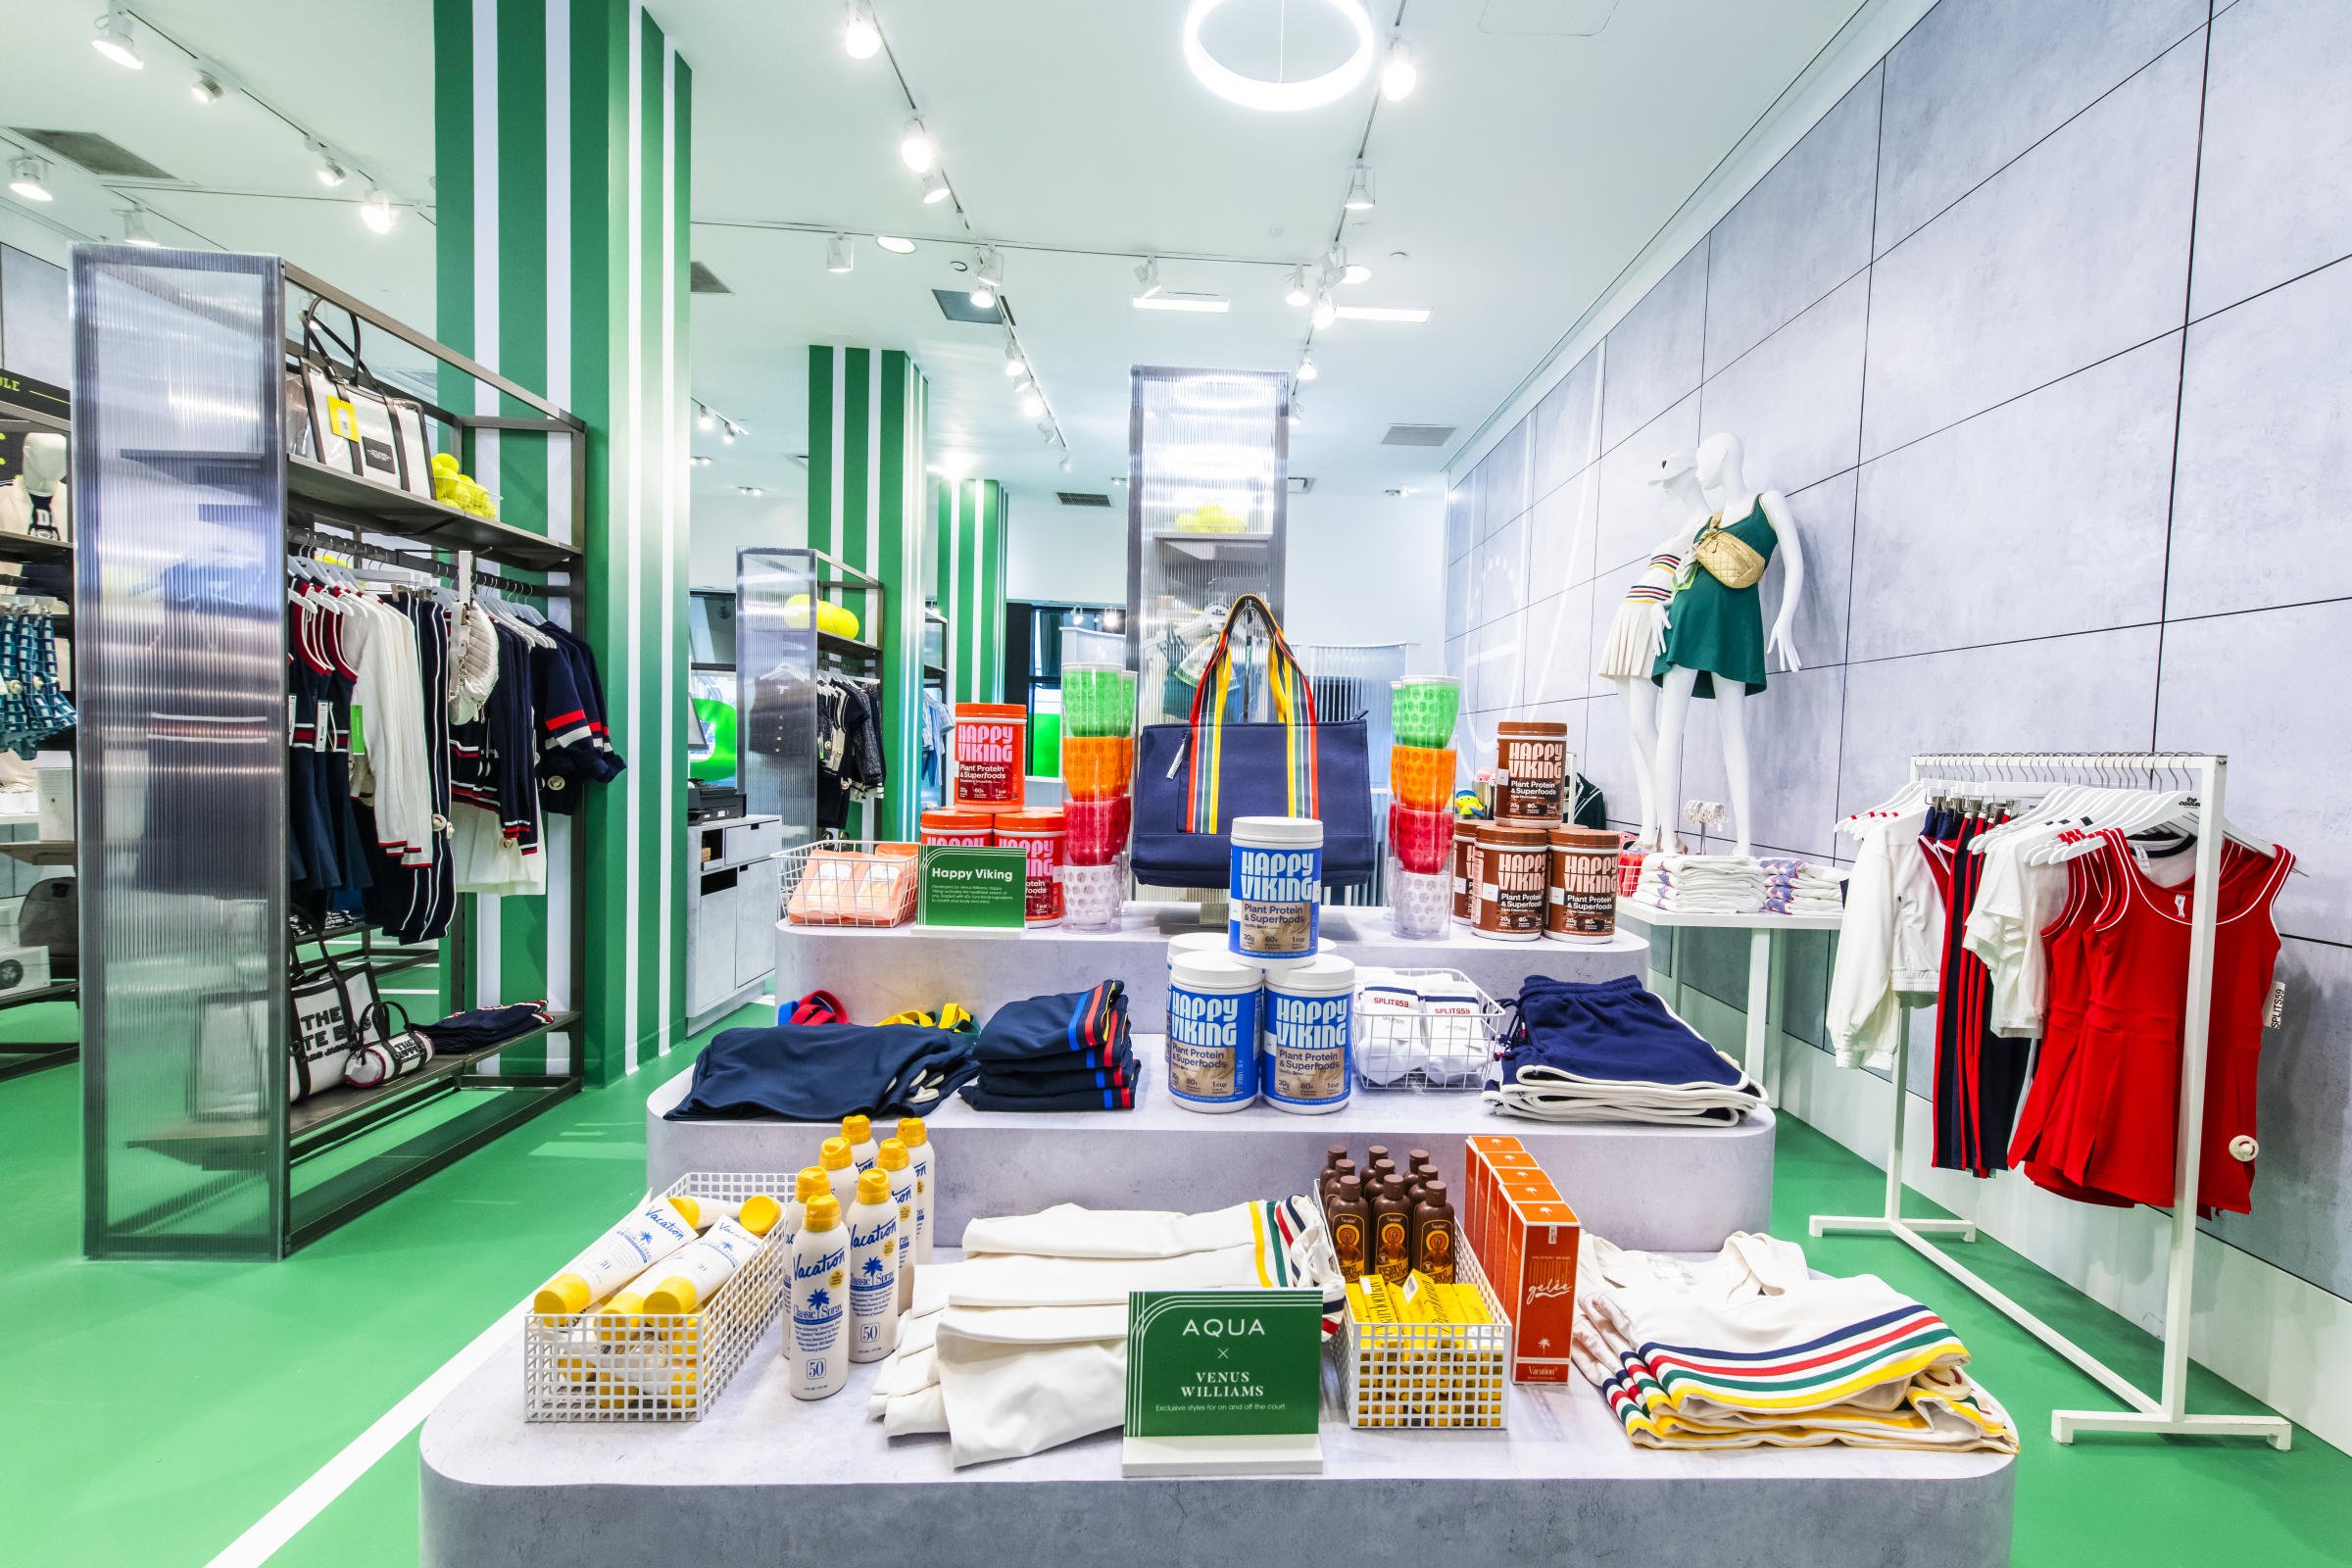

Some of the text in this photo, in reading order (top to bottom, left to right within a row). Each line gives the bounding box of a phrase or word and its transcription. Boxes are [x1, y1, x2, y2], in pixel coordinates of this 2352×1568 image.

[957, 724, 1013, 744] HAPPY
[957, 743, 1013, 762] VIKING
[1509, 742, 1563, 760] HAPPY
[1508, 760, 1562, 779] VIKING
[1026, 858, 1054, 876] ING
[1241, 851, 1314, 877] HAPPY
[1564, 855, 1618, 875] HAPPY
[932, 867, 1013, 882] Happy Viking
[1563, 872, 1617, 894] VIKING
[1240, 874, 1313, 902] VIKING
[1567, 894, 1588, 903] Plant
[1244, 904, 1303, 914] Plant Protein
[1250, 914, 1306, 924] Superfoods
[1172, 990, 1240, 1022] HAPPY
[1276, 997, 1348, 1024] HAPPY
[1373, 997, 1409, 1008] SPLITS59
[2271, 988, 2284, 1029] SPLITS59
[300, 1005, 343, 1031] THE
[1171, 1012, 1237, 1047] VIKING
[1275, 1019, 1347, 1049] VIKING
[1172, 1042, 1225, 1059] Plant Protein
[1279, 1049, 1338, 1061] Plant Protein
[1176, 1054, 1228, 1068] Superfoods
[1286, 1059, 1340, 1071] Superfoods
[645, 1205, 684, 1241] Vacation
[793, 1246, 845, 1282] Vacation
[850, 1273, 871, 1285] lassic
[862, 1324, 878, 1342] 50
[1182, 1318, 1266, 1338] AQUA
[808, 1360, 824, 1378] 50
[1196, 1371, 1250, 1383] VENUS
[1181, 1385, 1264, 1397] WILLIAMS
[1155, 1403, 1187, 1412] Exclusive
[1187, 1403, 1205, 1412] styles
